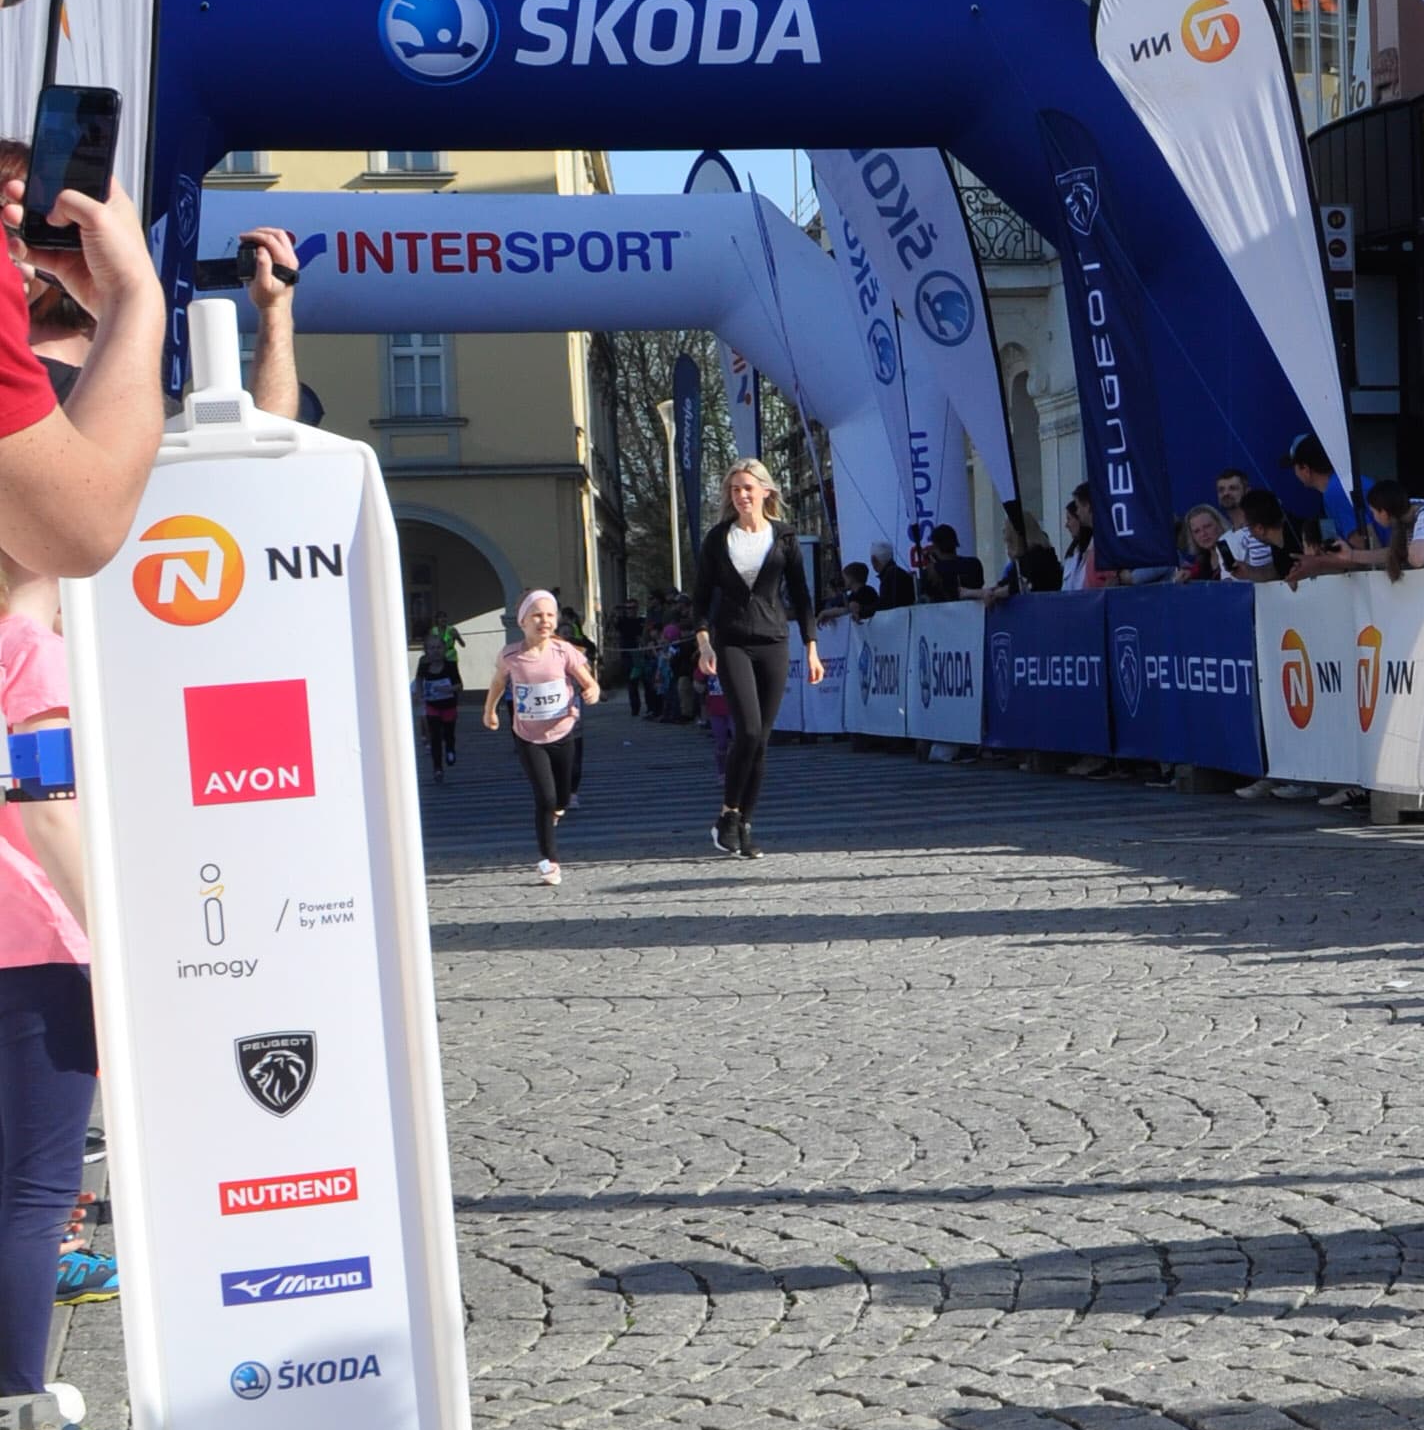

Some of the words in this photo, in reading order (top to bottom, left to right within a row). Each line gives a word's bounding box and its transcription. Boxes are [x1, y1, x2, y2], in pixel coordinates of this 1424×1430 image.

[336, 231, 681, 274] INTERSPORT
[1078, 252, 1135, 537] PEUGEOT
[265, 543, 343, 581] NN
[871, 644, 900, 697] ŠKODA
[921, 641, 974, 698] ŠKODA
[1014, 656, 1101, 686] PEUGEOT
[1145, 656, 1252, 696] PEUGEOT
[1316, 661, 1342, 693] NN
[1385, 660, 1415, 695] NN
[534, 693, 561, 707] 3157
[204, 766, 301, 795] AVON
[299, 898, 355, 914] Powered
[300, 915, 316, 929] by
[321, 912, 355, 925] MVM
[177, 958, 258, 979] innogy
[242, 1037, 309, 1052] PEUGEOT
[226, 1175, 352, 1208] NUTREND
[277, 1354, 382, 1390] ŠKODA
